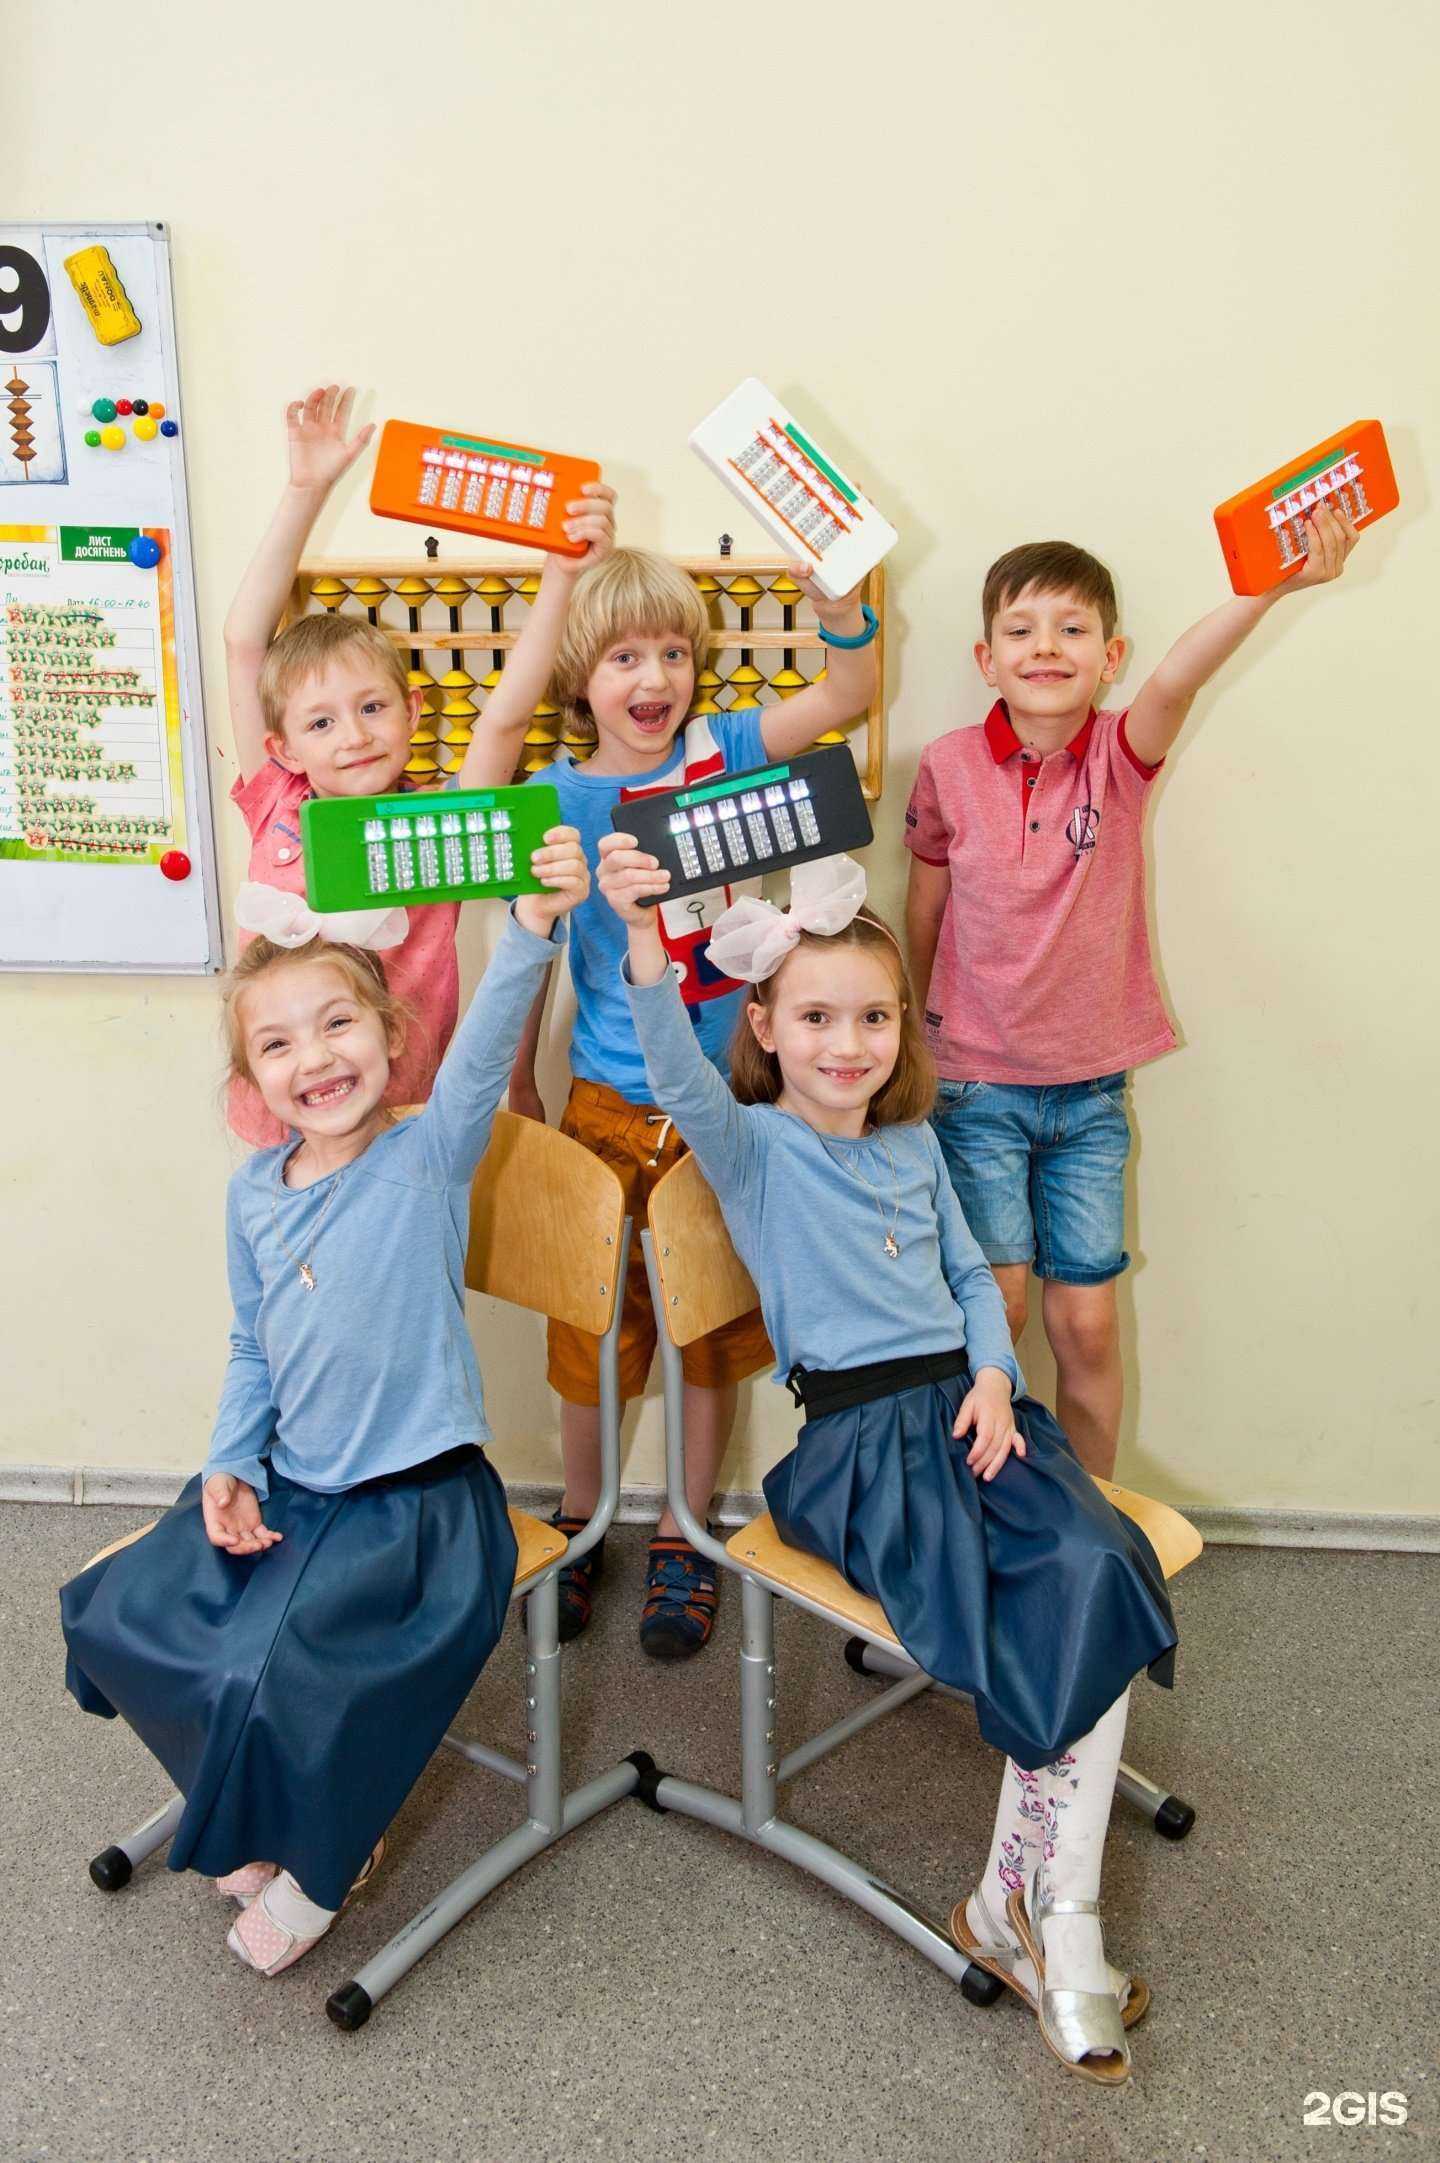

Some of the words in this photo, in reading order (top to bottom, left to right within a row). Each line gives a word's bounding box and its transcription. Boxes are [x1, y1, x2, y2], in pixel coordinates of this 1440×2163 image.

[0, 245, 51, 354] 9
[80, 281, 101, 317] magnetic
[97, 270, 116, 302] DONAU
[74, 545, 128, 559] ДОСЯГНЕНЬ
[88, 535, 112, 547] ЛИСТ
